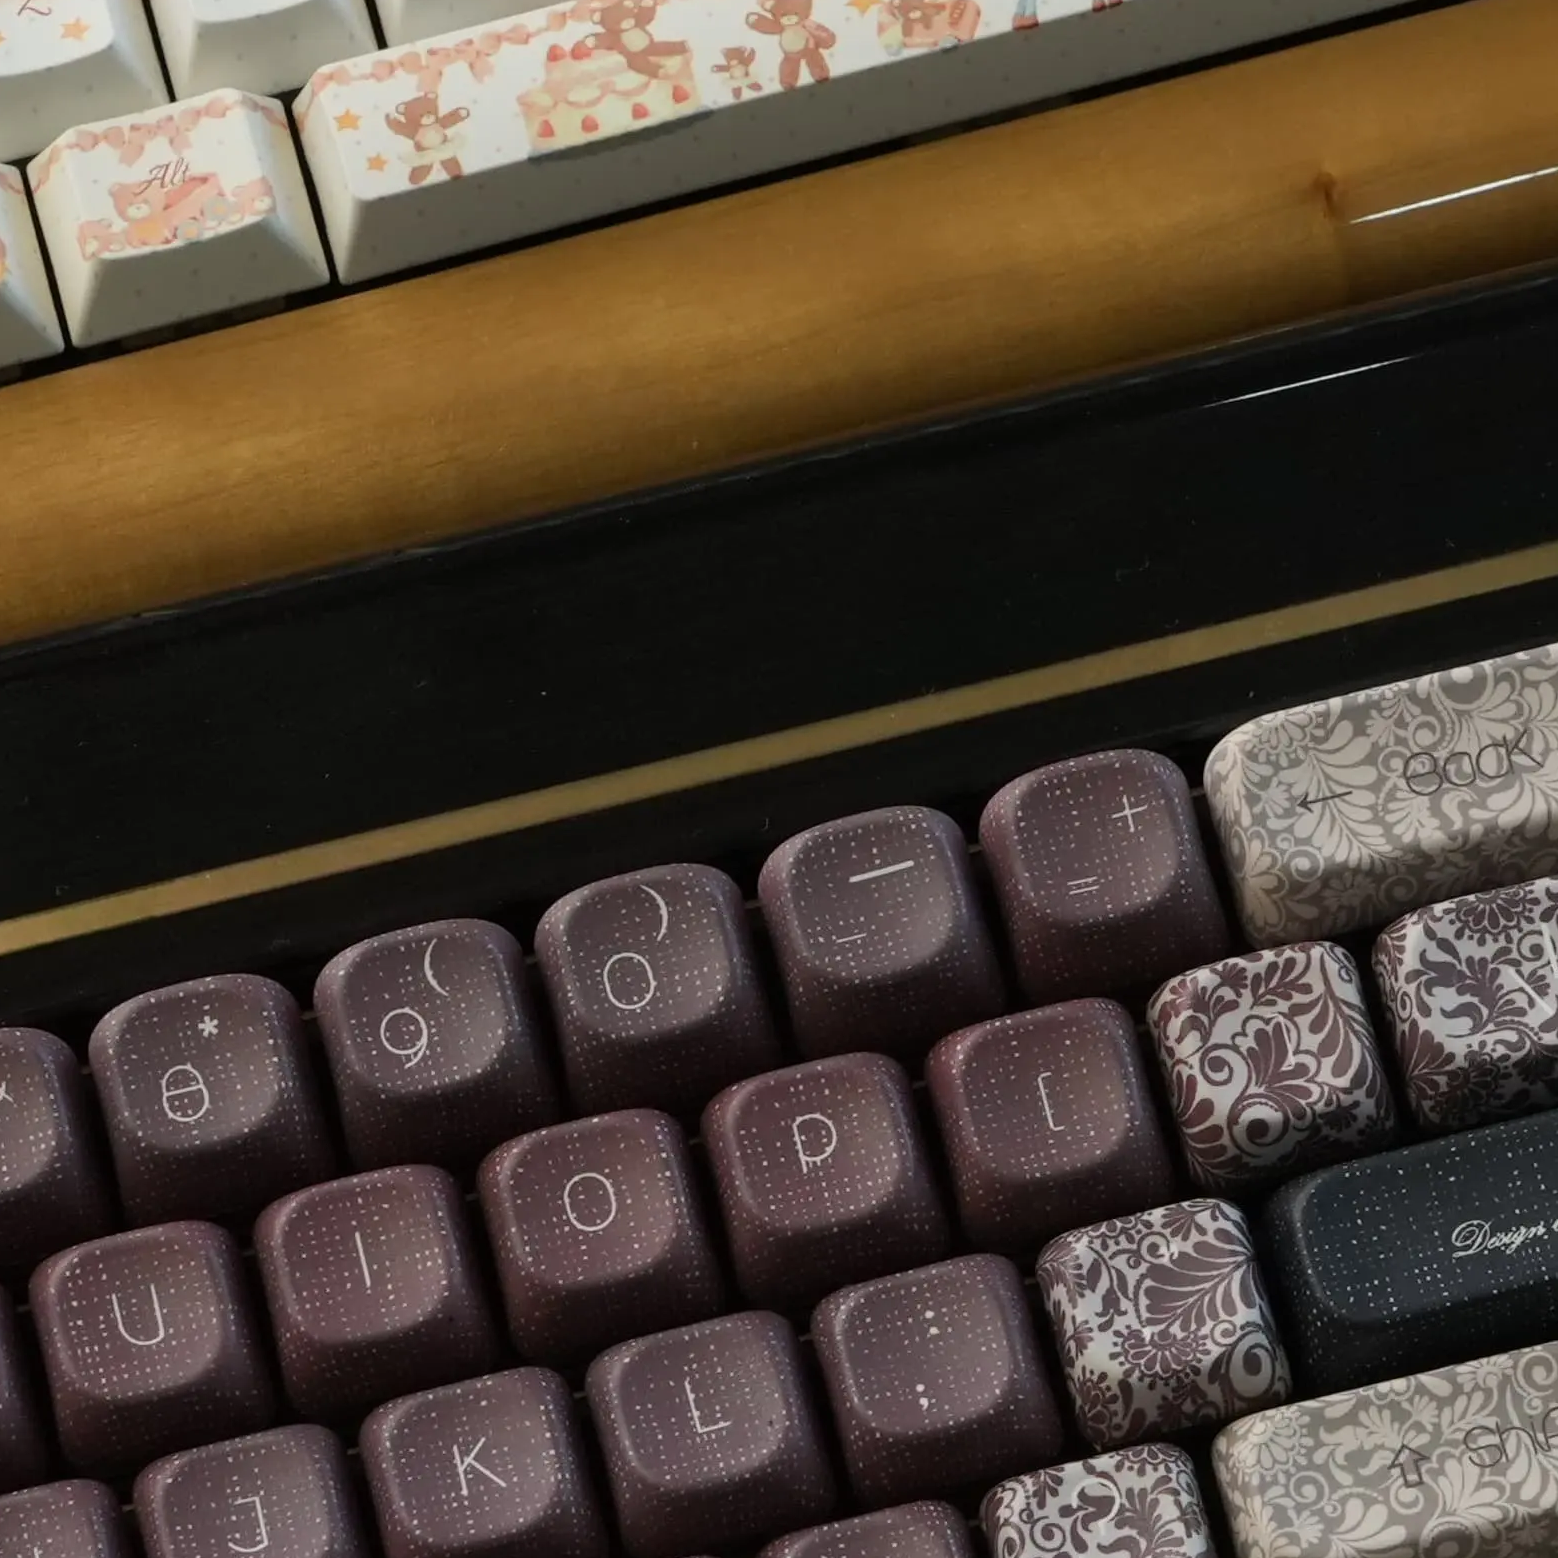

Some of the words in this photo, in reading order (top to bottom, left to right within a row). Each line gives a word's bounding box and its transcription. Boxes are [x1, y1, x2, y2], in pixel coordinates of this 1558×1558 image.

[138, 157, 190, 197] Alt
[793, 1113, 839, 1174] P
[1451, 1219, 1547, 1259] Design
[112, 1285, 165, 1346] U
[683, 1378, 733, 1435] L
[451, 1436, 508, 1497] K
